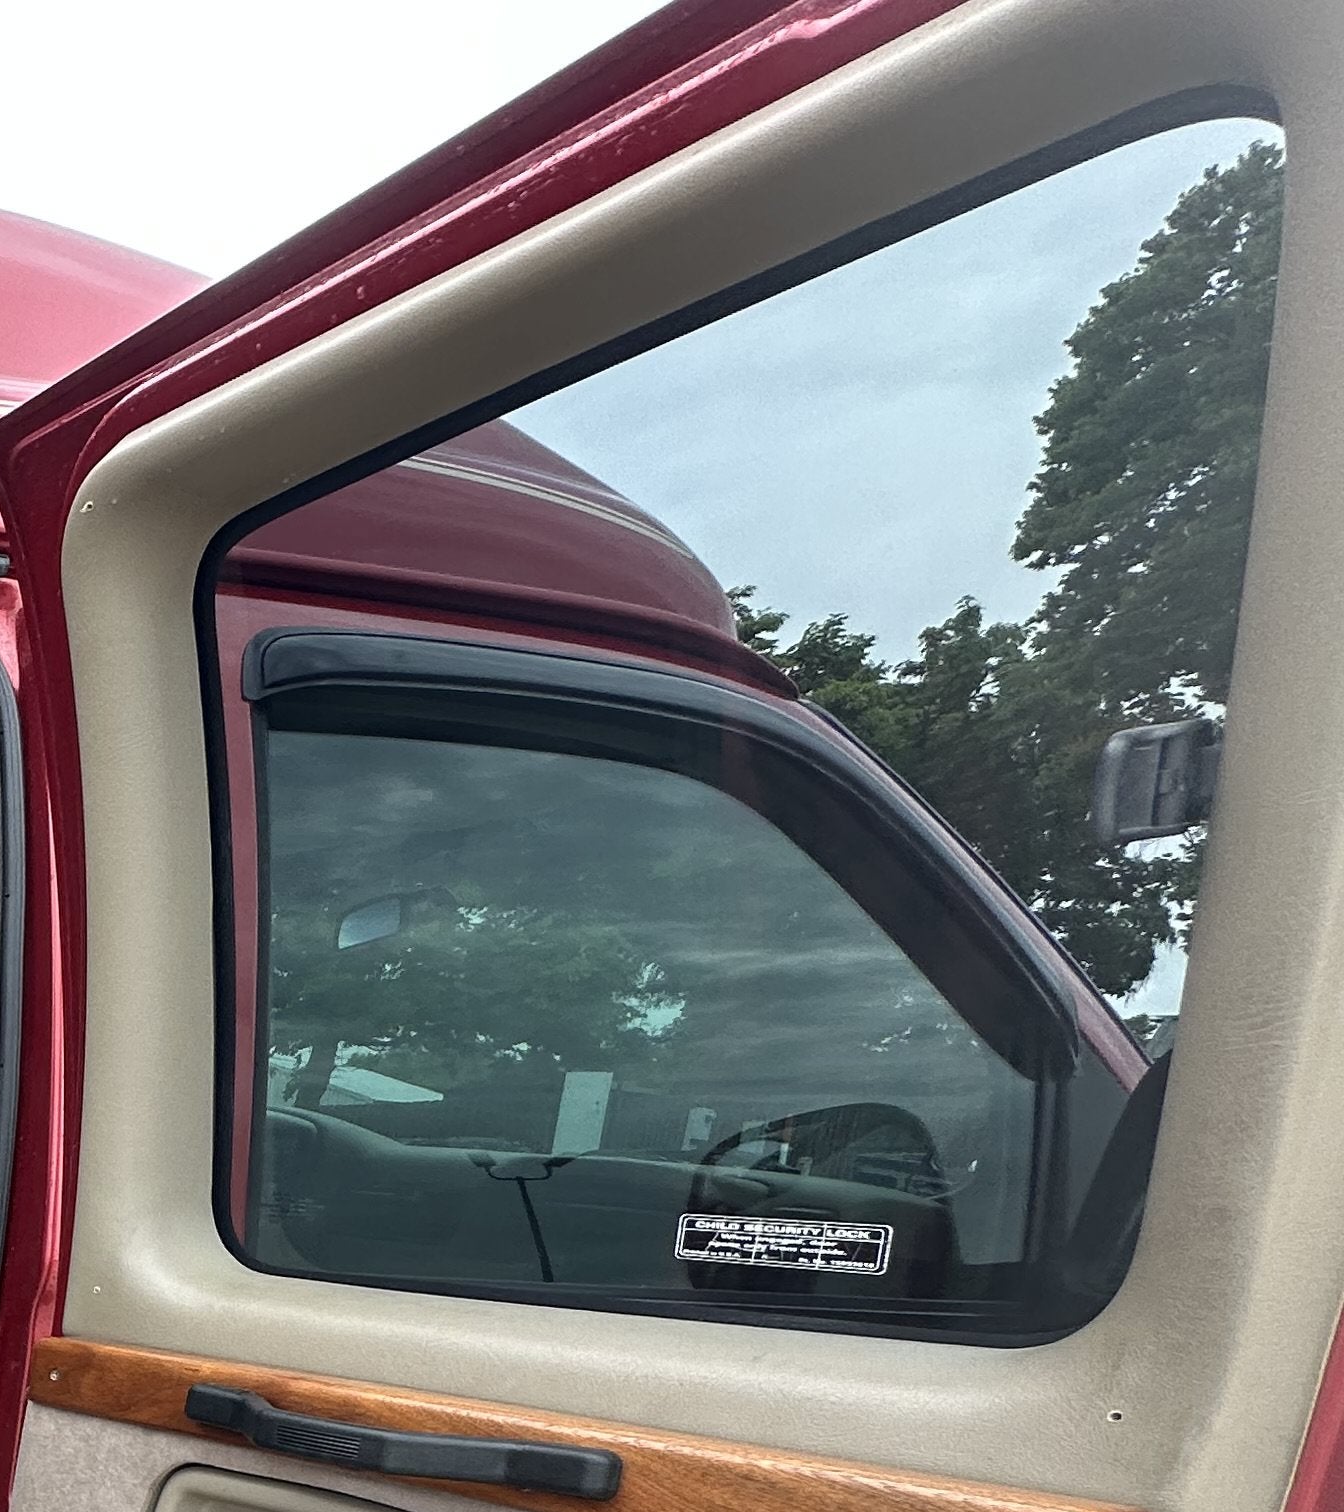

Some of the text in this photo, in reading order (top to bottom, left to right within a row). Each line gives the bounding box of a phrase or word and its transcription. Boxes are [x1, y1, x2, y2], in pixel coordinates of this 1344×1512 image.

[695, 1220, 871, 1240] CHILD SECURITY LOCK
